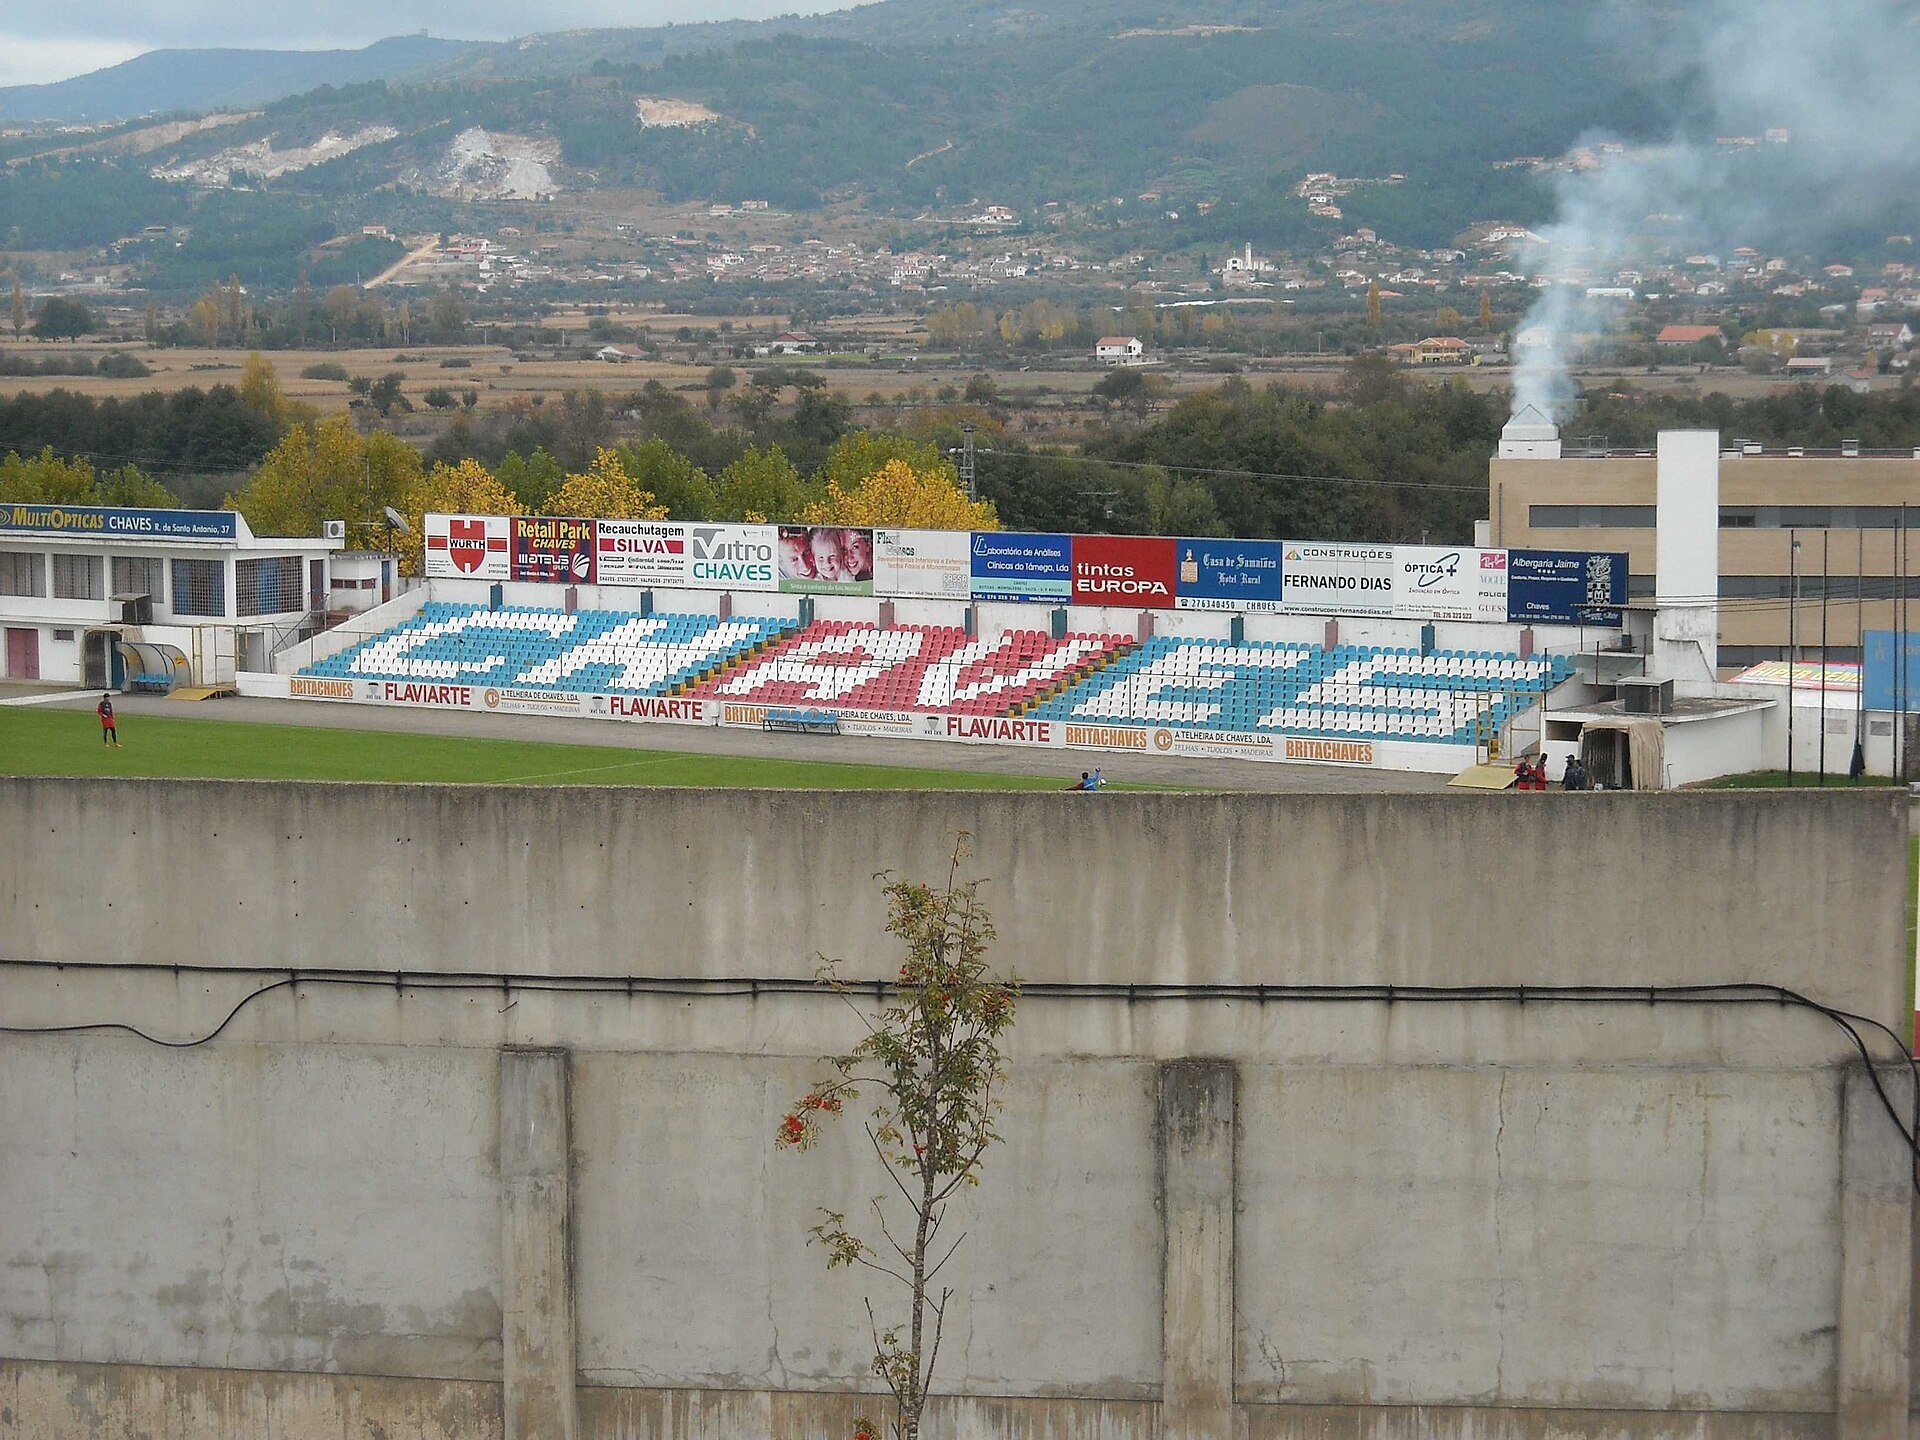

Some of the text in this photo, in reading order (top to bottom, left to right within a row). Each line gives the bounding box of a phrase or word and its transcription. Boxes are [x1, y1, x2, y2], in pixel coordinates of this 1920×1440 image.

[108, 516, 152, 531] CHAVES
[154, 523, 161, 531] R.
[163, 523, 171, 532] de
[172, 523, 191, 533] Santo
[221, 525, 230, 534] 37
[517, 520, 591, 540] Retail Park
[599, 522, 684, 539] Recauchutagem
[532, 538, 577, 549] CHAVES
[616, 538, 665, 554] SILVA
[693, 528, 772, 561] Vitro
[973, 535, 1061, 557] Laboratório de Análises
[987, 561, 1014, 570] Clínicas
[1076, 562, 1135, 577] tintas
[1203, 553, 1224, 570] Casa
[1226, 556, 1235, 567] de
[1404, 562, 1444, 574] ÓPTICA
[1512, 557, 1580, 570] Albergaria Jaime
[693, 562, 772, 581] CHAVES
[1217, 572, 1261, 587] Hotel Rural
[1076, 579, 1169, 596] EUROPA
[1284, 574, 1392, 591] FERNANDO DIAS
[1246, 601, 1276, 611] CHAVES
[1478, 604, 1507, 613] GUESS
[1526, 601, 1550, 611] Chaves
[290, 679, 354, 698] BRITACHAVES
[385, 682, 471, 706] FLAVIARTE
[506, 690, 533, 699] TELHEIRA
[533, 692, 542, 700] DE
[542, 692, 566, 702] CHAVES,
[610, 696, 703, 721] FLAVIARTE
[860, 711, 869, 720] DE
[869, 712, 896, 722] CHAVES,
[946, 716, 1050, 743] FLAVIARTE
[1065, 726, 1147, 748] BRITACHAVES
[1174, 731, 1180, 739] A
[1181, 731, 1214, 741] TELHEIRA
[1215, 733, 1225, 741] DE
[1226, 733, 1255, 744] CHAVES,
[1285, 739, 1373, 762] BRITACHAVES
